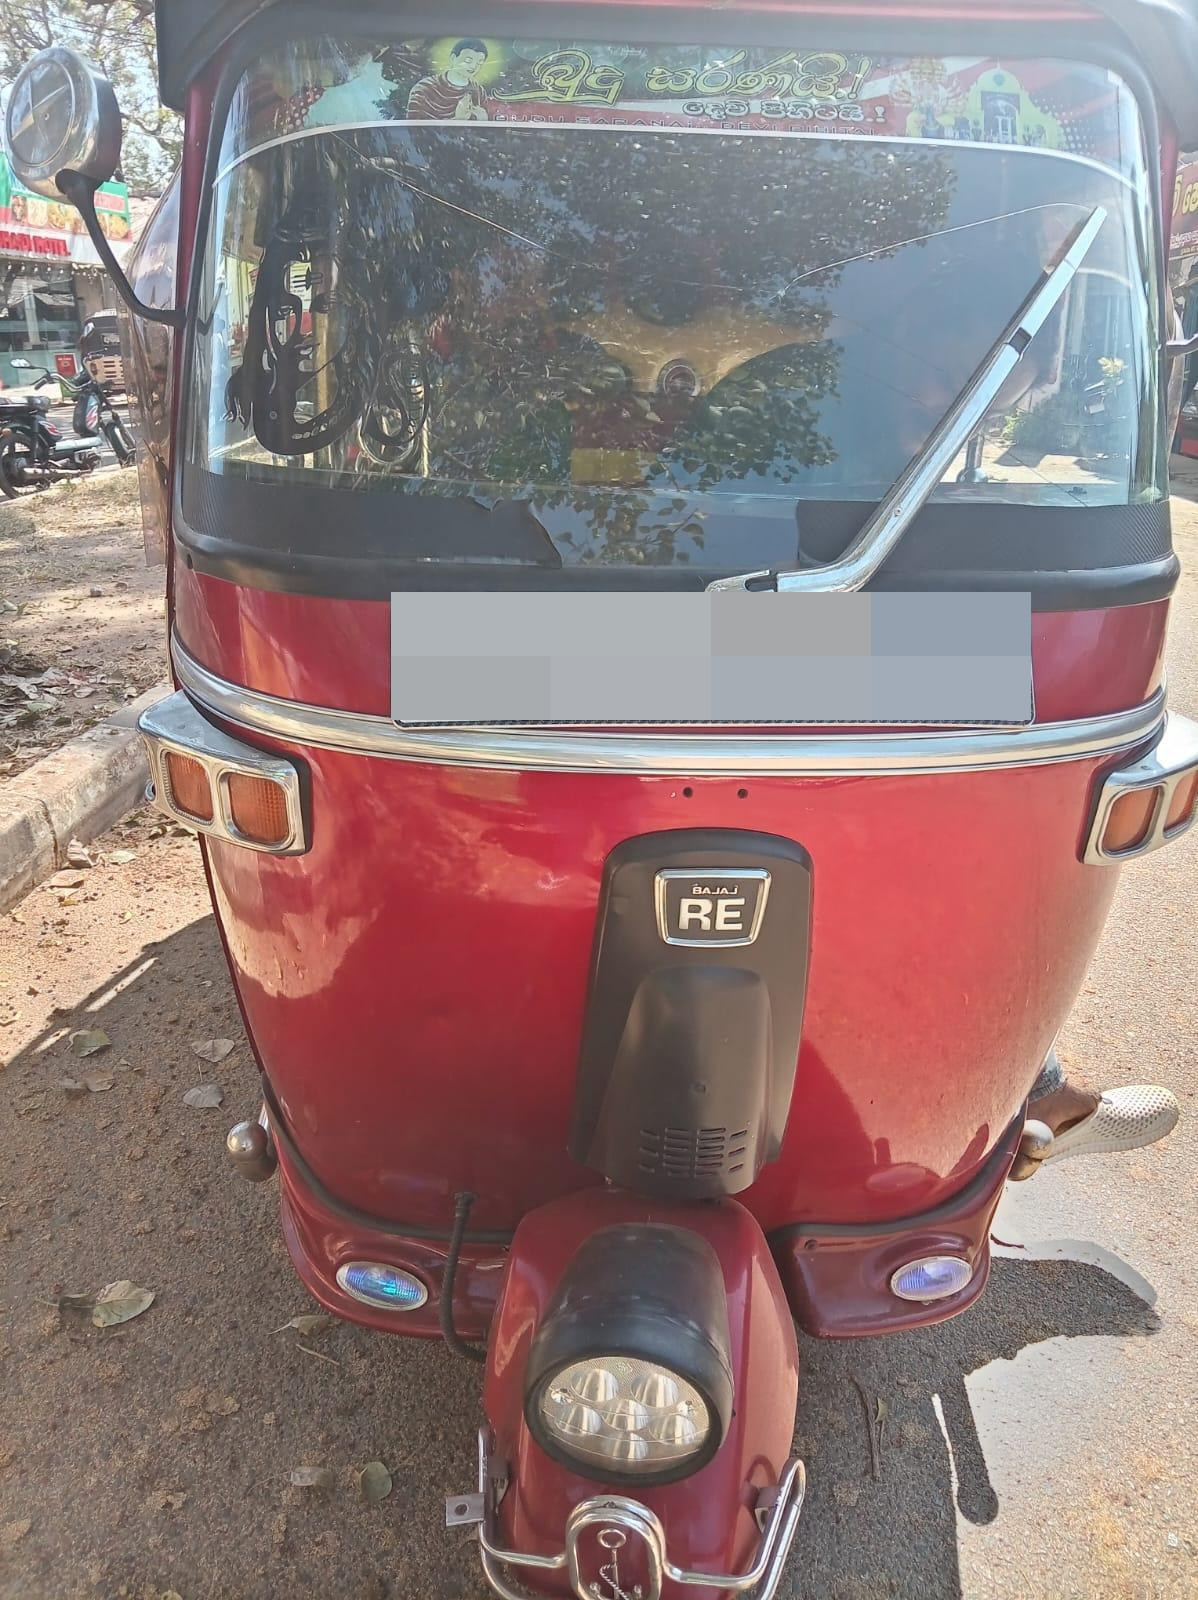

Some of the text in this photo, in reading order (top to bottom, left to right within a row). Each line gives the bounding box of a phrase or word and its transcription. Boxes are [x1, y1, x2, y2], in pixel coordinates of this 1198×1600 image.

[491, 48, 625, 107] බුදු
[692, 885, 739, 896] BAJAJ
[678, 898, 746, 931] RE
